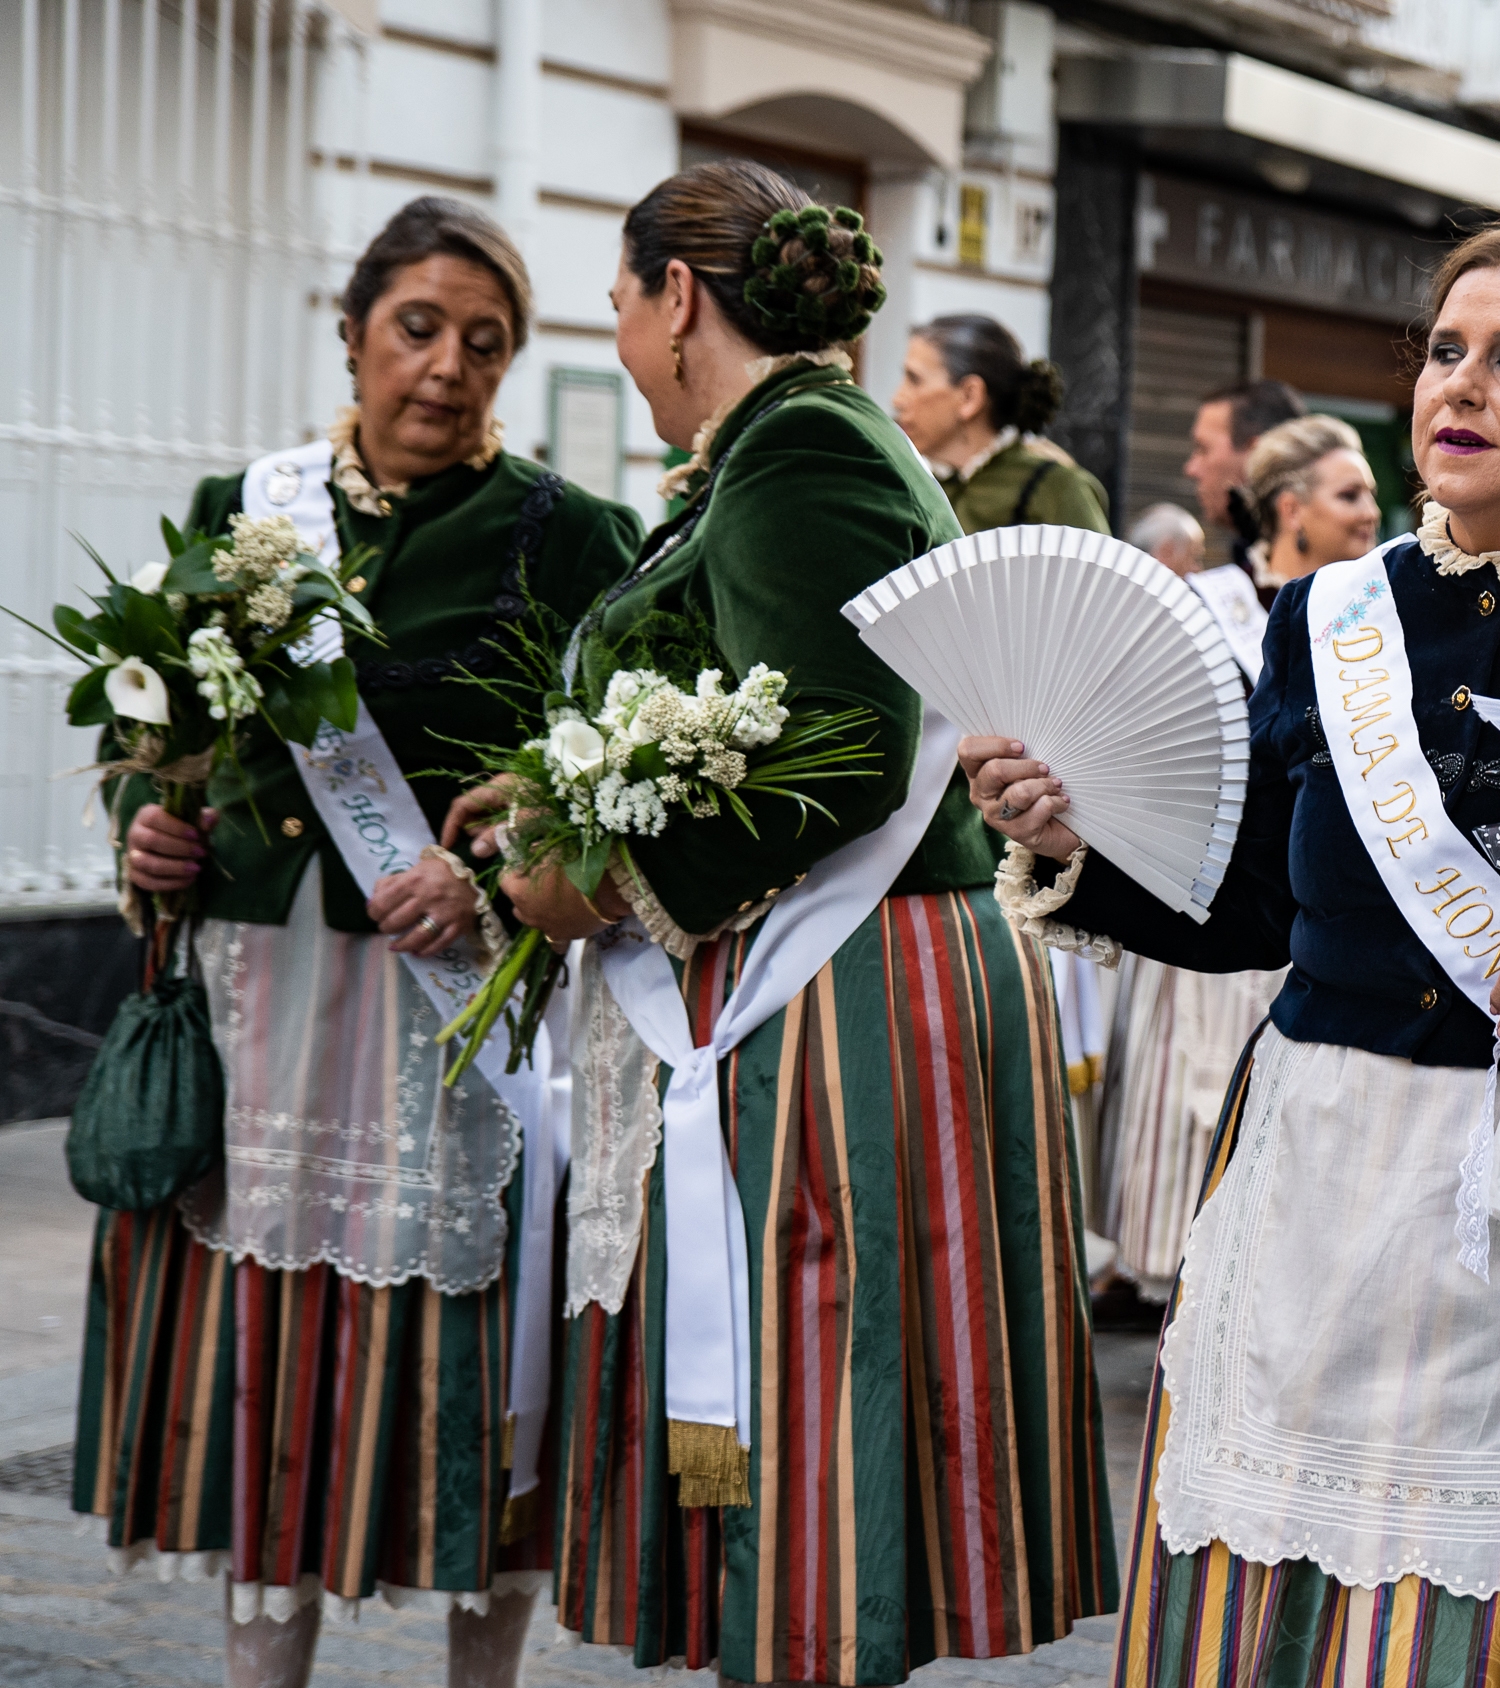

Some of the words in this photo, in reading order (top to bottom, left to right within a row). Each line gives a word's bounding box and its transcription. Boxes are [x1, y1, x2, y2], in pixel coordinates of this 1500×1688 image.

[1331, 626, 1401, 782] DAMA
[1373, 780, 1430, 859] DE
[341, 793, 413, 876] HON
[435, 948, 484, 989] 995
